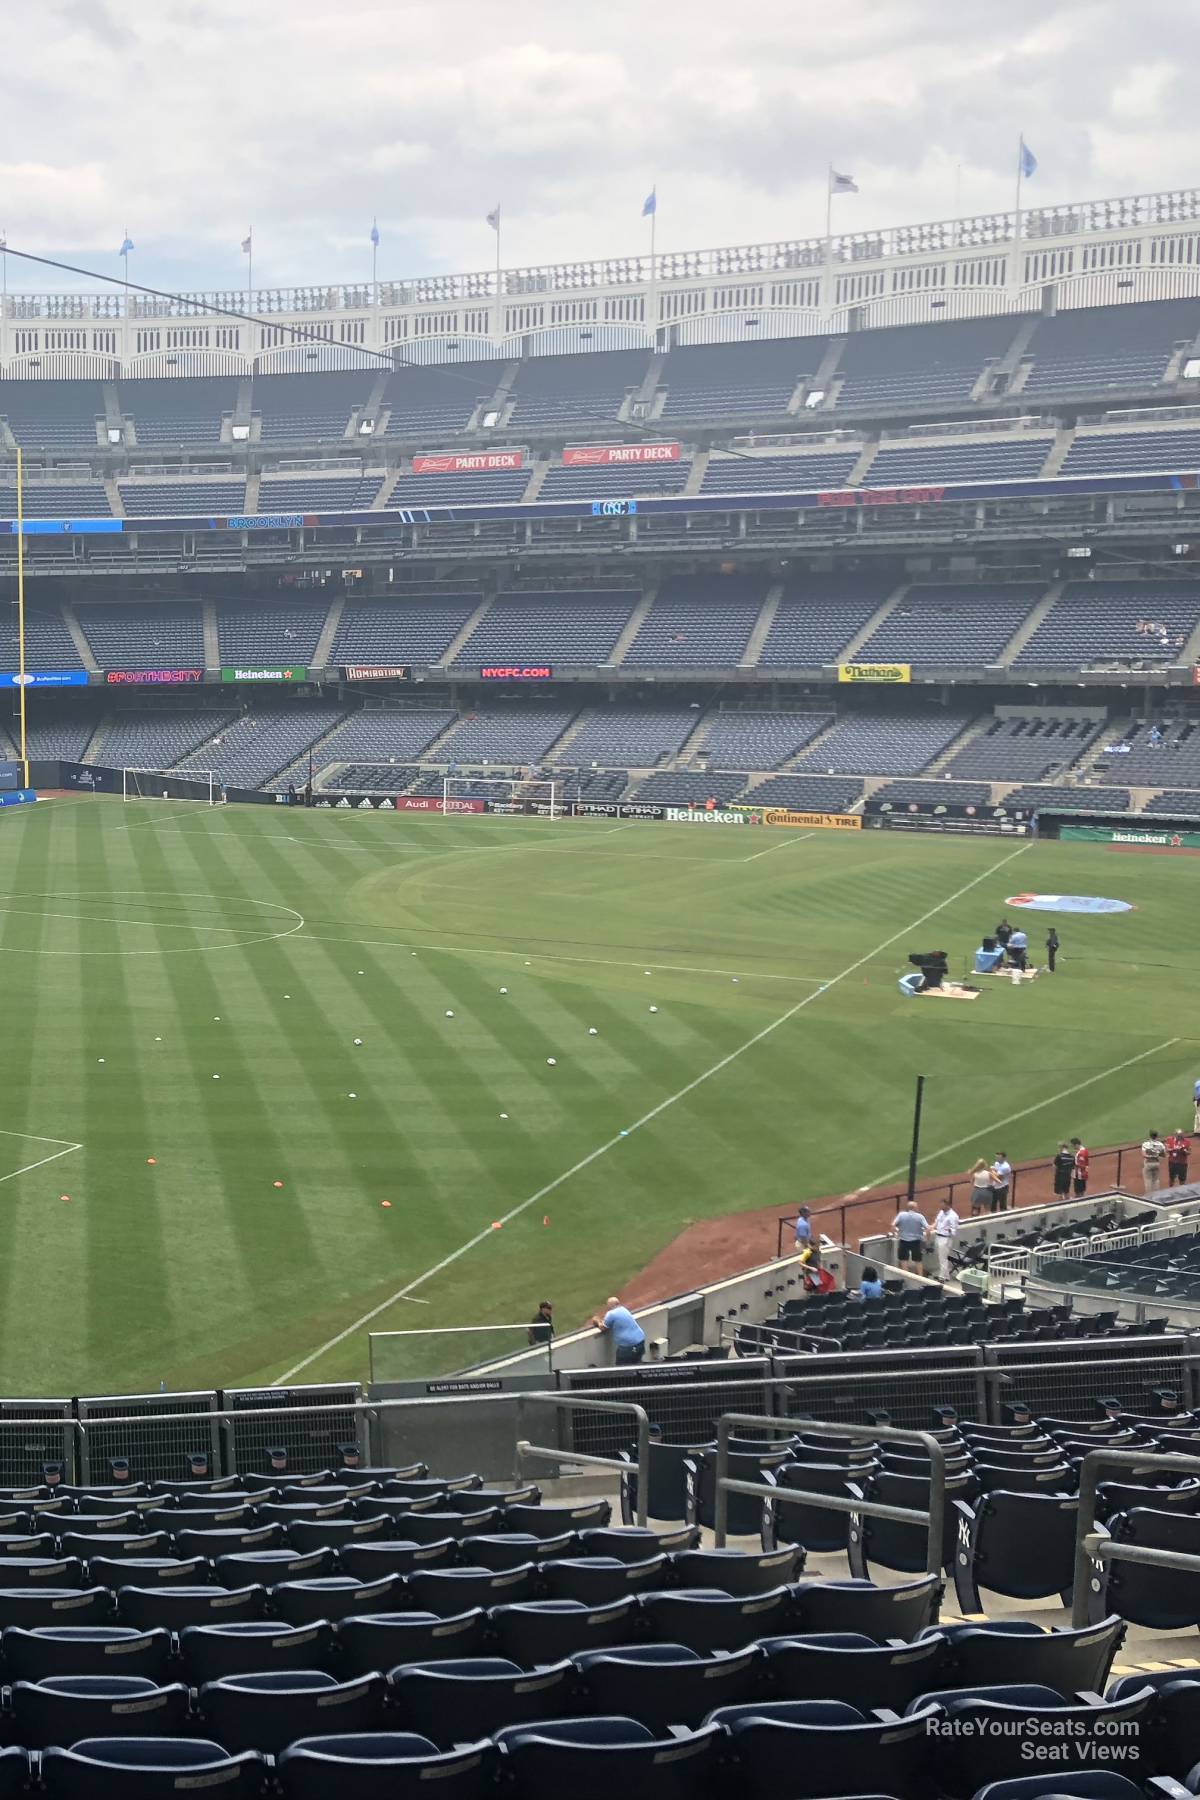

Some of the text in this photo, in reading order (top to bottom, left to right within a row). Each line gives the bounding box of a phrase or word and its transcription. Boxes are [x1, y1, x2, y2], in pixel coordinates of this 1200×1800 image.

[608, 449, 642, 461] PARTY
[644, 447, 672, 459] DECK
[455, 457, 486, 468] PARTY
[488, 455, 515, 467] DECK
[227, 515, 303, 529] BROOKLYN
[235, 669, 283, 680] Heineken
[348, 667, 402, 679] ADMIRATION
[481, 668, 549, 677] NYCFC.COM
[405, 800, 429, 808] Audi
[577, 804, 615, 813] ETIHAD
[622, 806, 662, 815] ETIHAD
[666, 808, 743, 824] Heineken
[765, 812, 858, 827] Continental TIRE
[1112, 833, 1167, 845] Heineken
